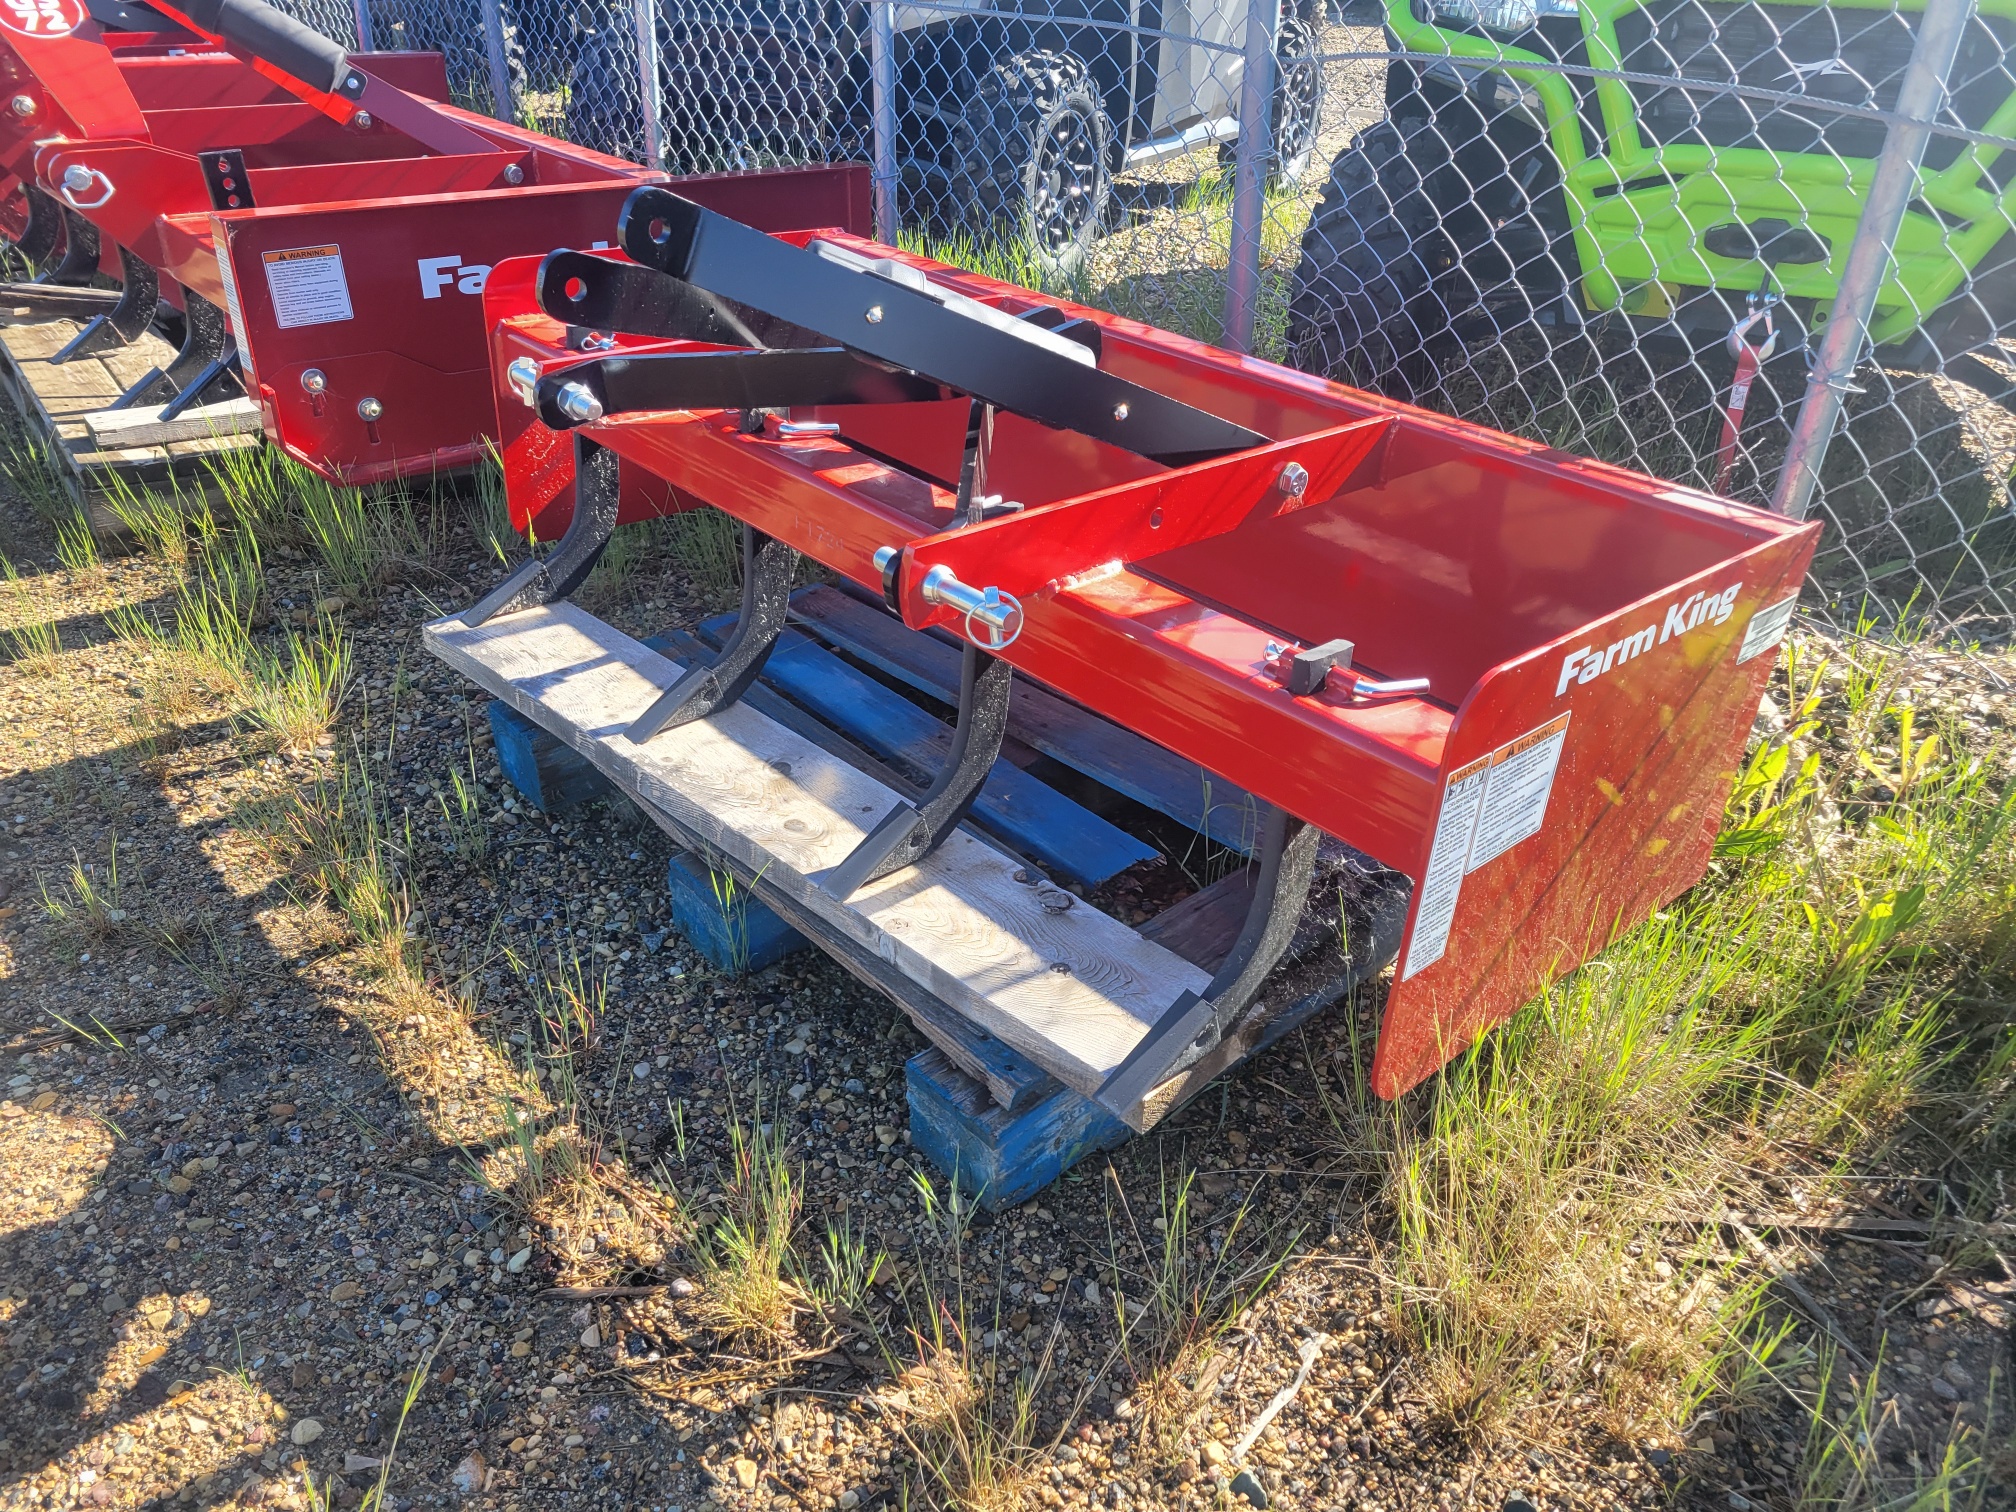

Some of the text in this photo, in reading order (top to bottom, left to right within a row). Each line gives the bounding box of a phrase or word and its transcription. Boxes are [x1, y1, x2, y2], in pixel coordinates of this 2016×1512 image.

[15, 9, 71, 31] 72
[288, 249, 326, 259] WARNING
[417, 255, 492, 299] Fa
[1555, 624, 1656, 698] Farm
[1658, 582, 1743, 645] King
[1517, 725, 1555, 752] WARNING
[1456, 758, 1489, 779] WARNING
